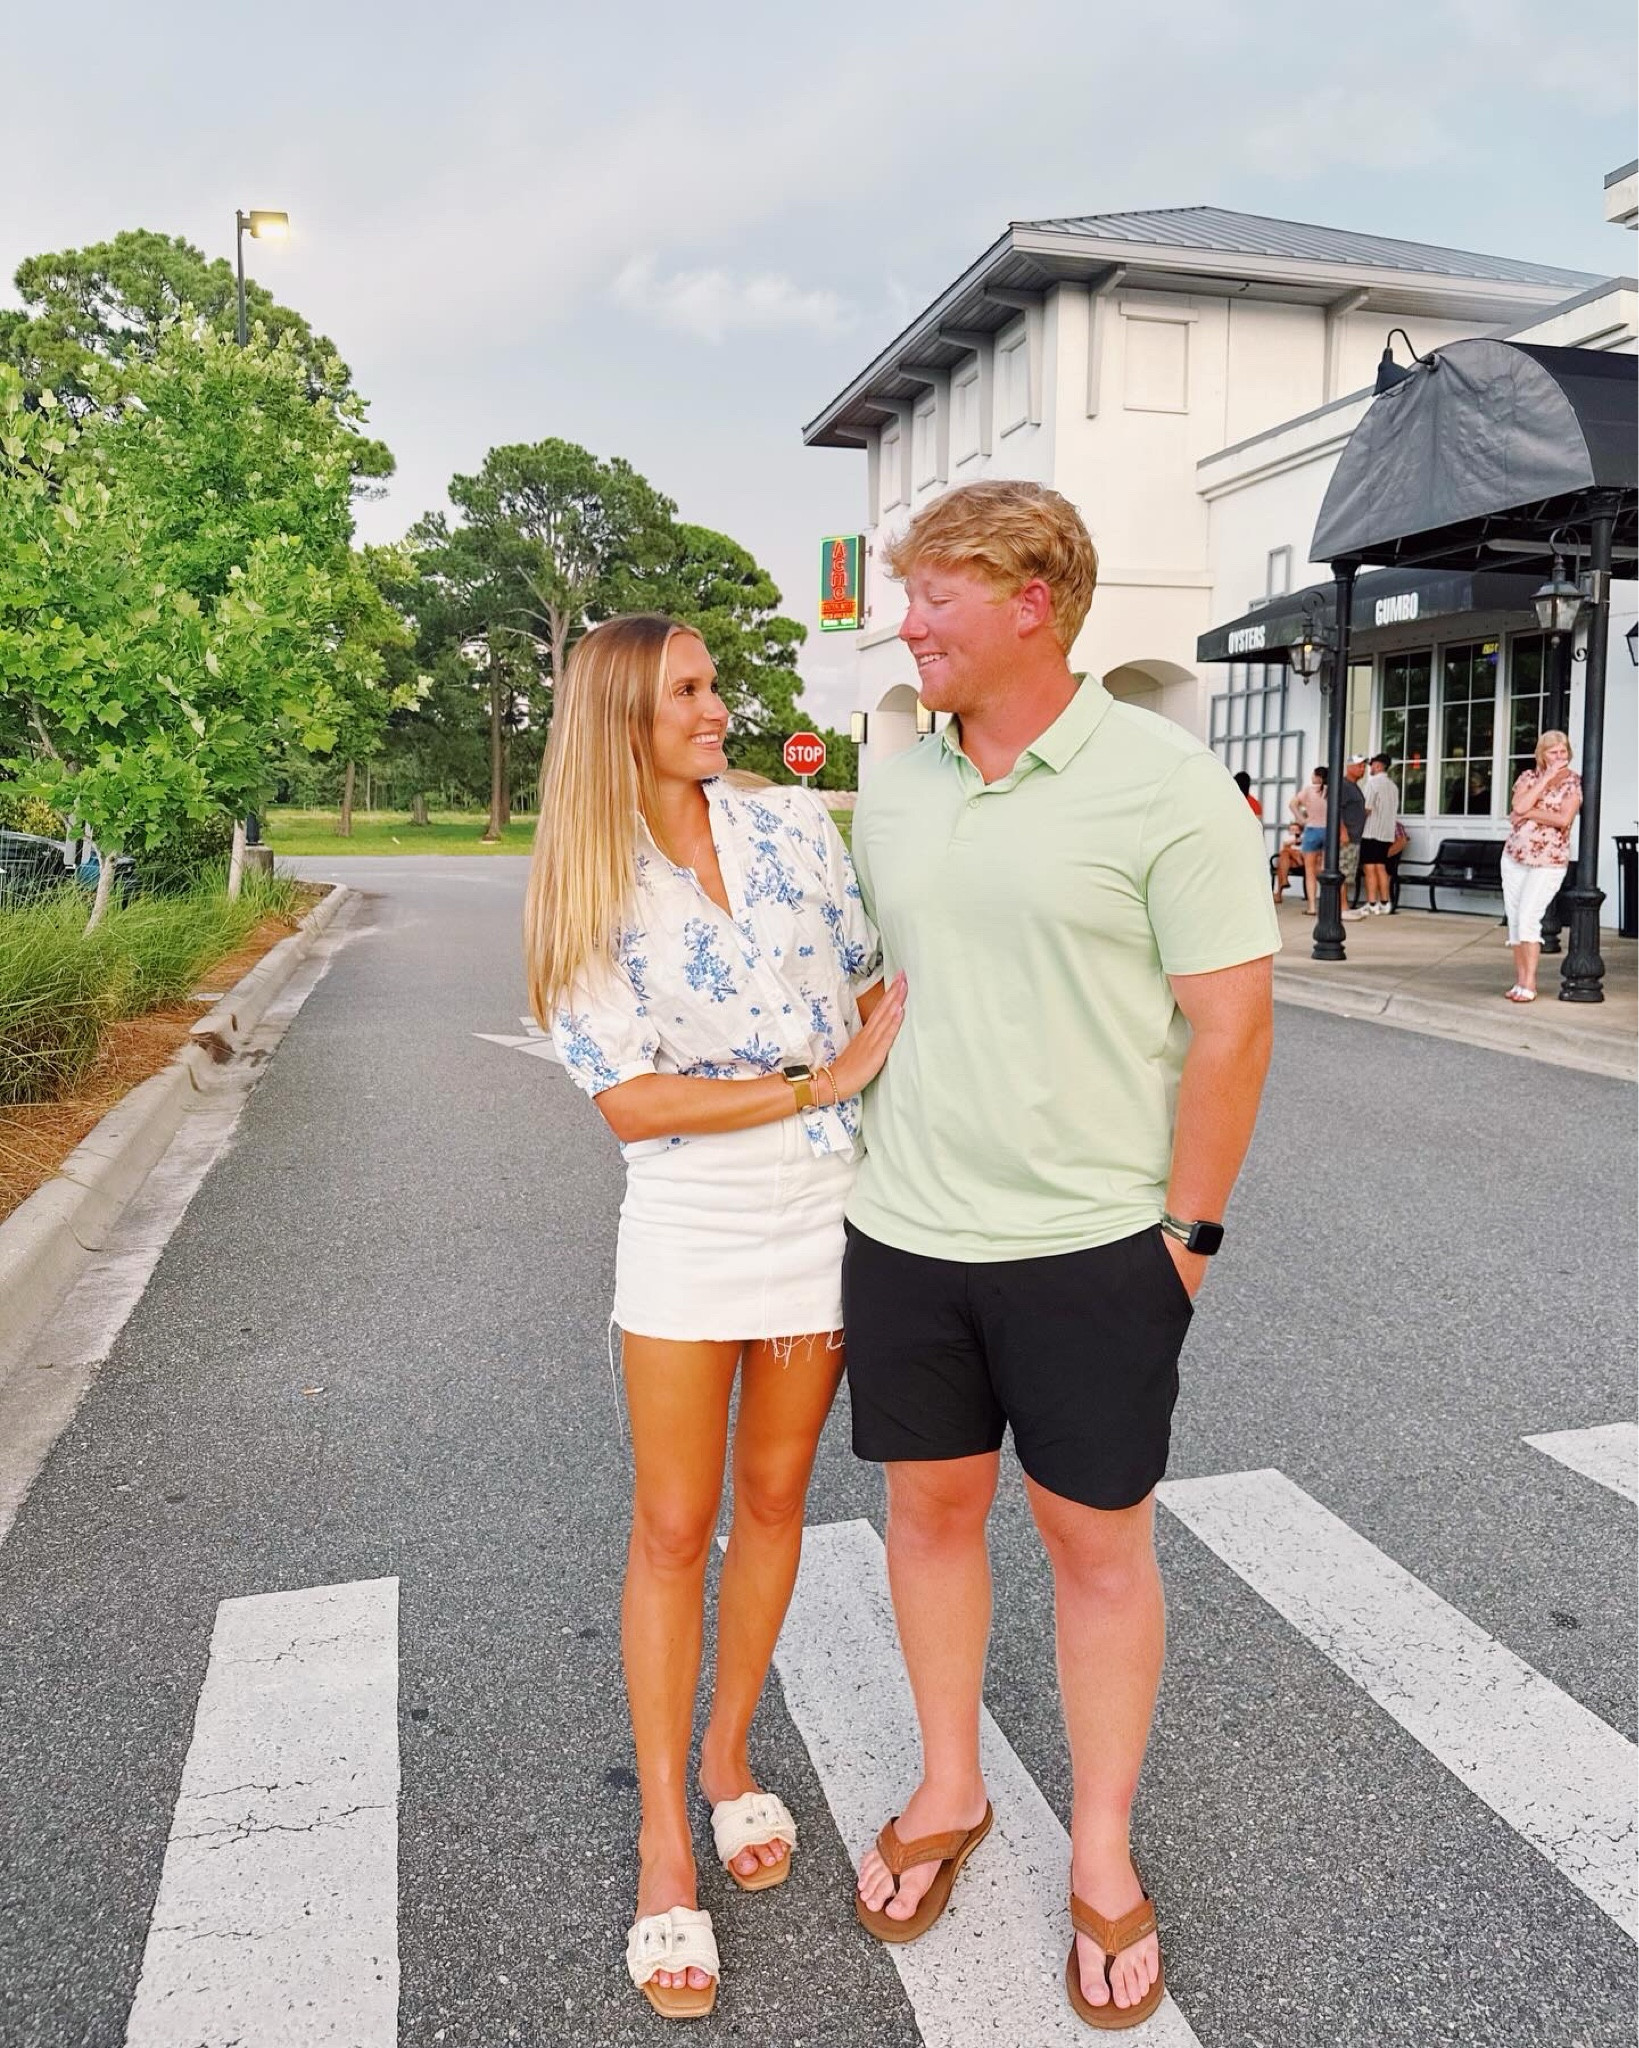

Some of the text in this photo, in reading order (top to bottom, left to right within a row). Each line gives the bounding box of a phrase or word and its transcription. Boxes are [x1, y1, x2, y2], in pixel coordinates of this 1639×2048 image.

[1375, 592, 1419, 626] GUMBO
[1228, 625, 1266, 654] OYSTERS
[787, 745, 823, 762] STOP
